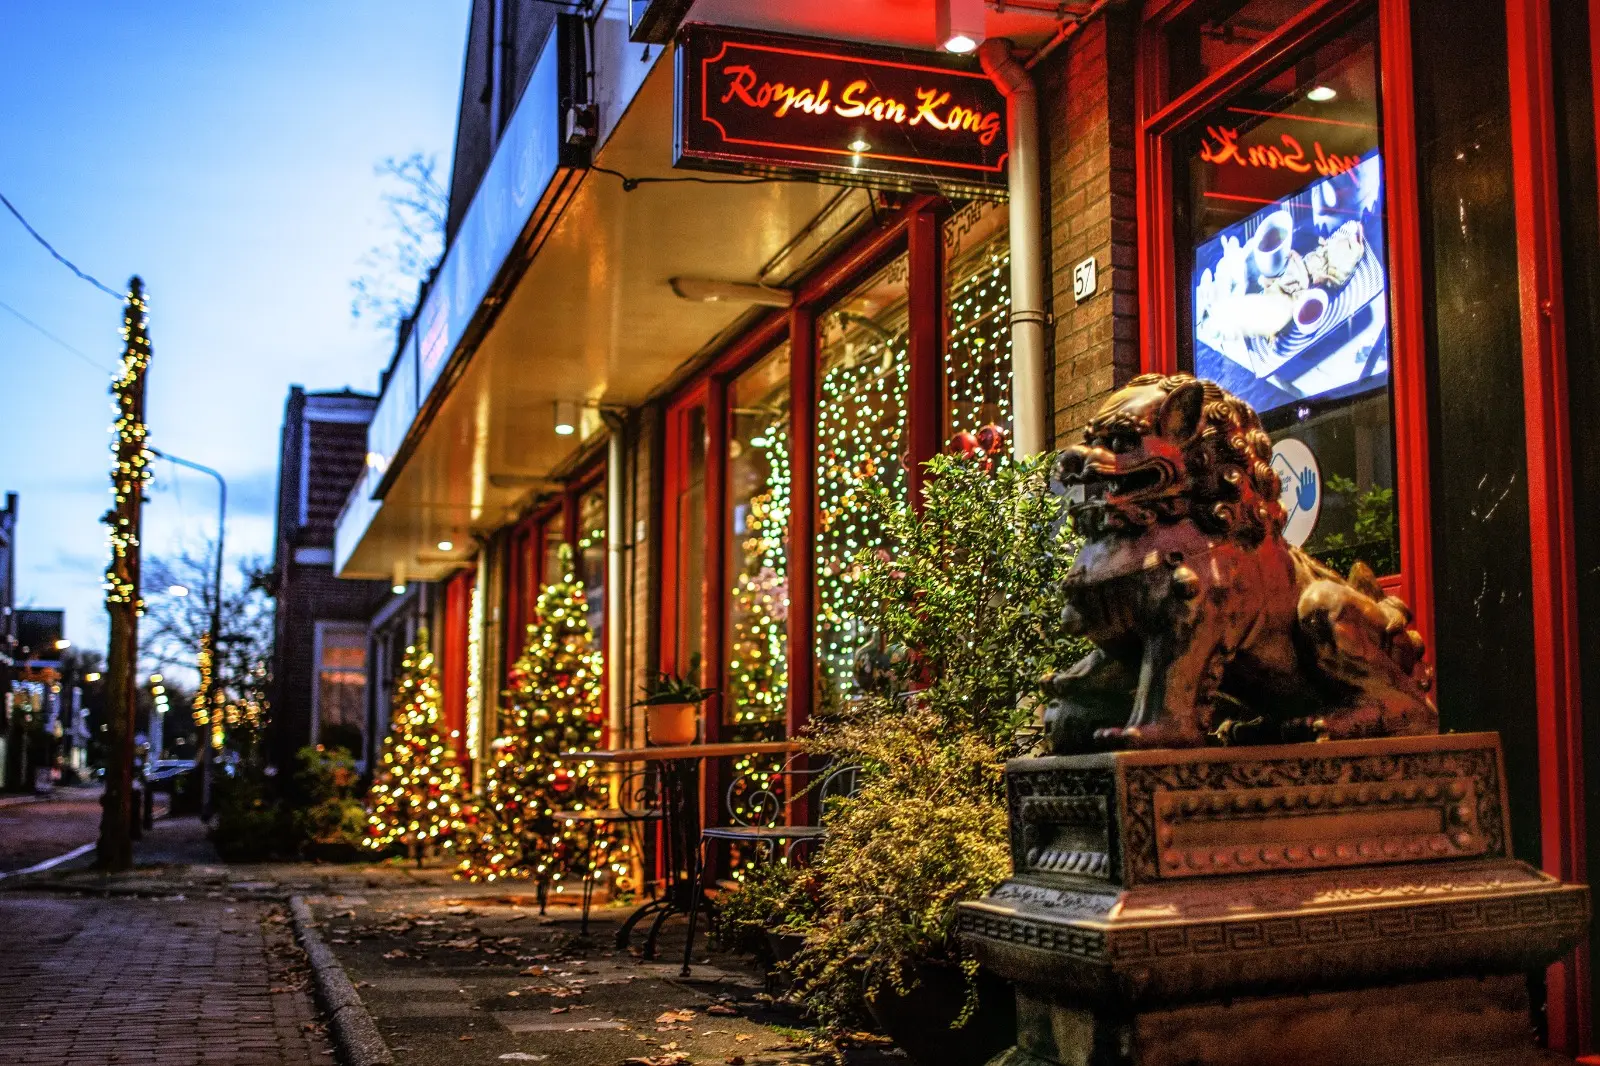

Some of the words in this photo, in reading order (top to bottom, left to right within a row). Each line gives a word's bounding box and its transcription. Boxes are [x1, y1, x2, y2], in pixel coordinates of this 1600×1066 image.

[721, 65, 831, 118] Royal
[834, 79, 906, 123] San
[909, 87, 1000, 146] Kong
[1076, 261, 1093, 296] 57
